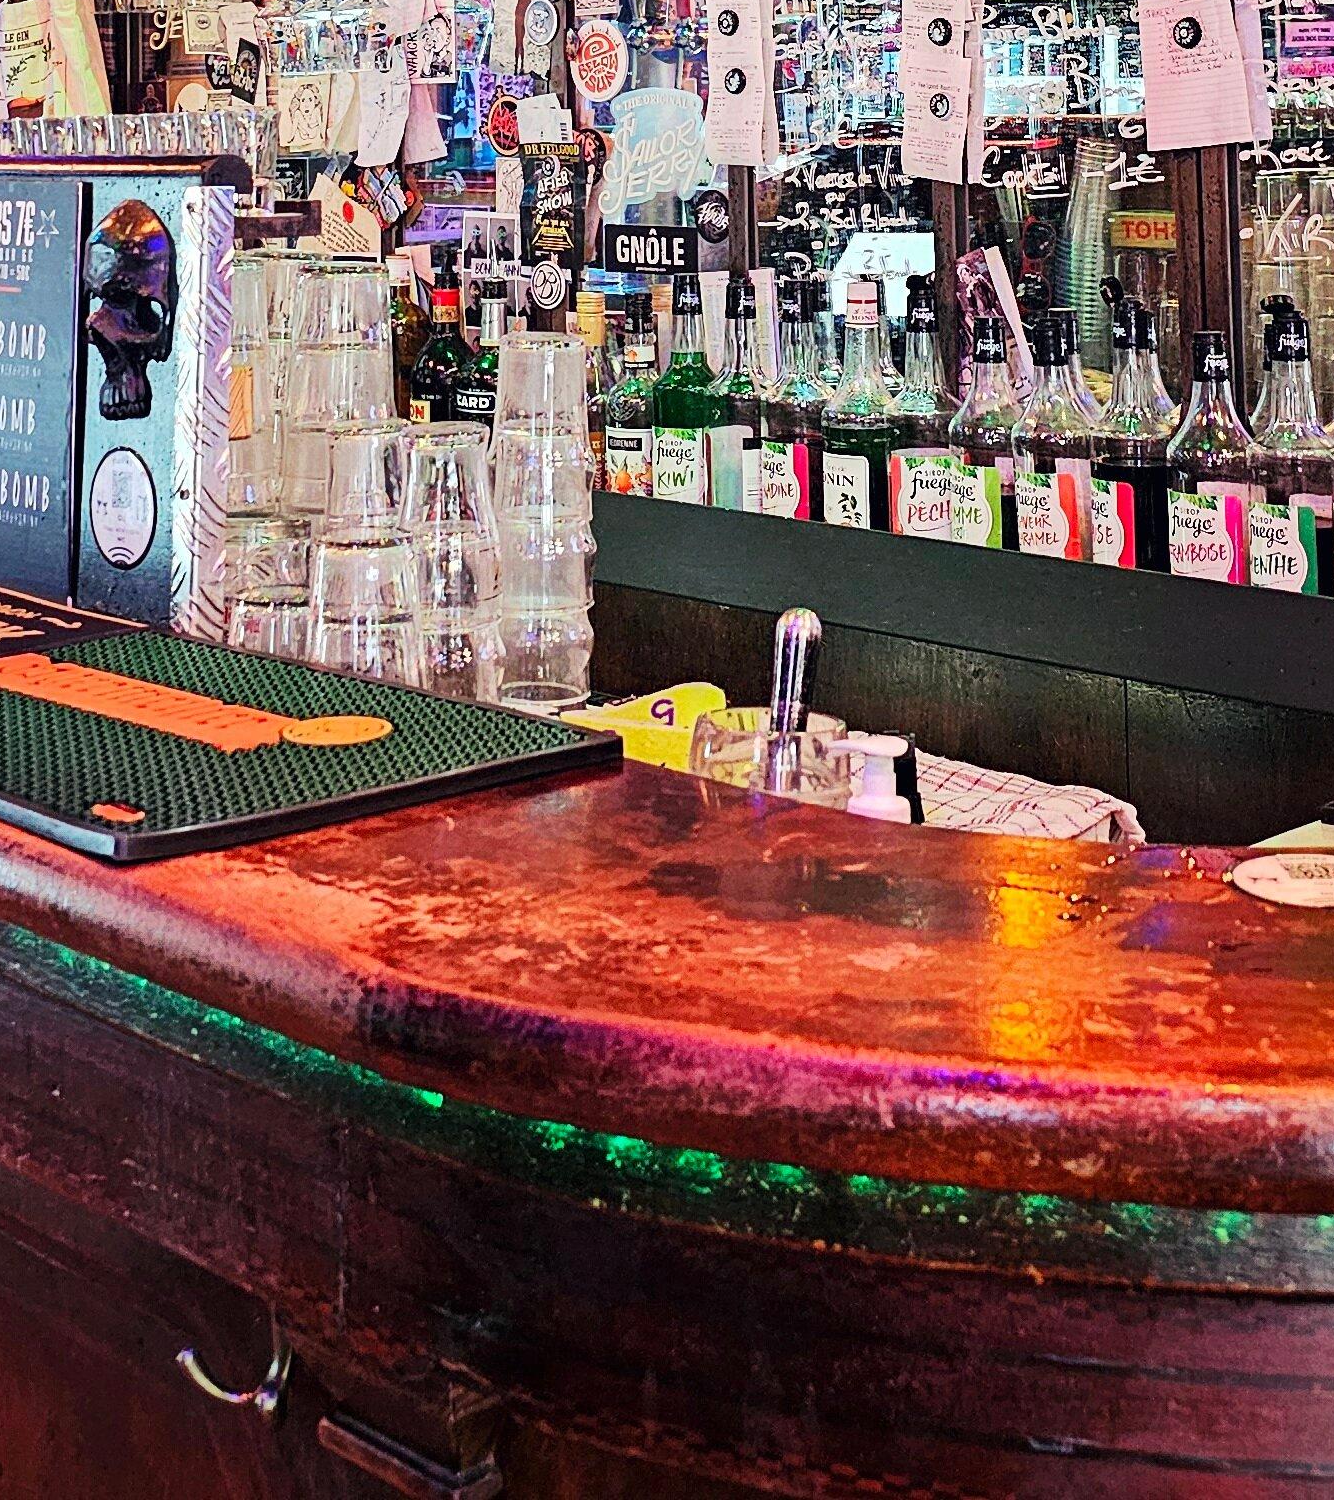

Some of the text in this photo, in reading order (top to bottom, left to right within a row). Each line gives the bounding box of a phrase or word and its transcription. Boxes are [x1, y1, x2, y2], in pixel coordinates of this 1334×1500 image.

[578, 54, 618, 80] BELOW
[585, 71, 616, 93] SUN
[603, 116, 697, 181] SAILOR
[598, 150, 701, 214] JERRY
[536, 190, 573, 215] SHOW
[15, 200, 36, 247] 7€
[617, 228, 685, 265] GNÔLE
[609, 437, 639, 448] EDRENNE
[657, 440, 694, 465] fuego
[658, 466, 693, 488] KIWI
[1172, 506, 1215, 536] fuego
[1254, 554, 1298, 576] ENTHE
